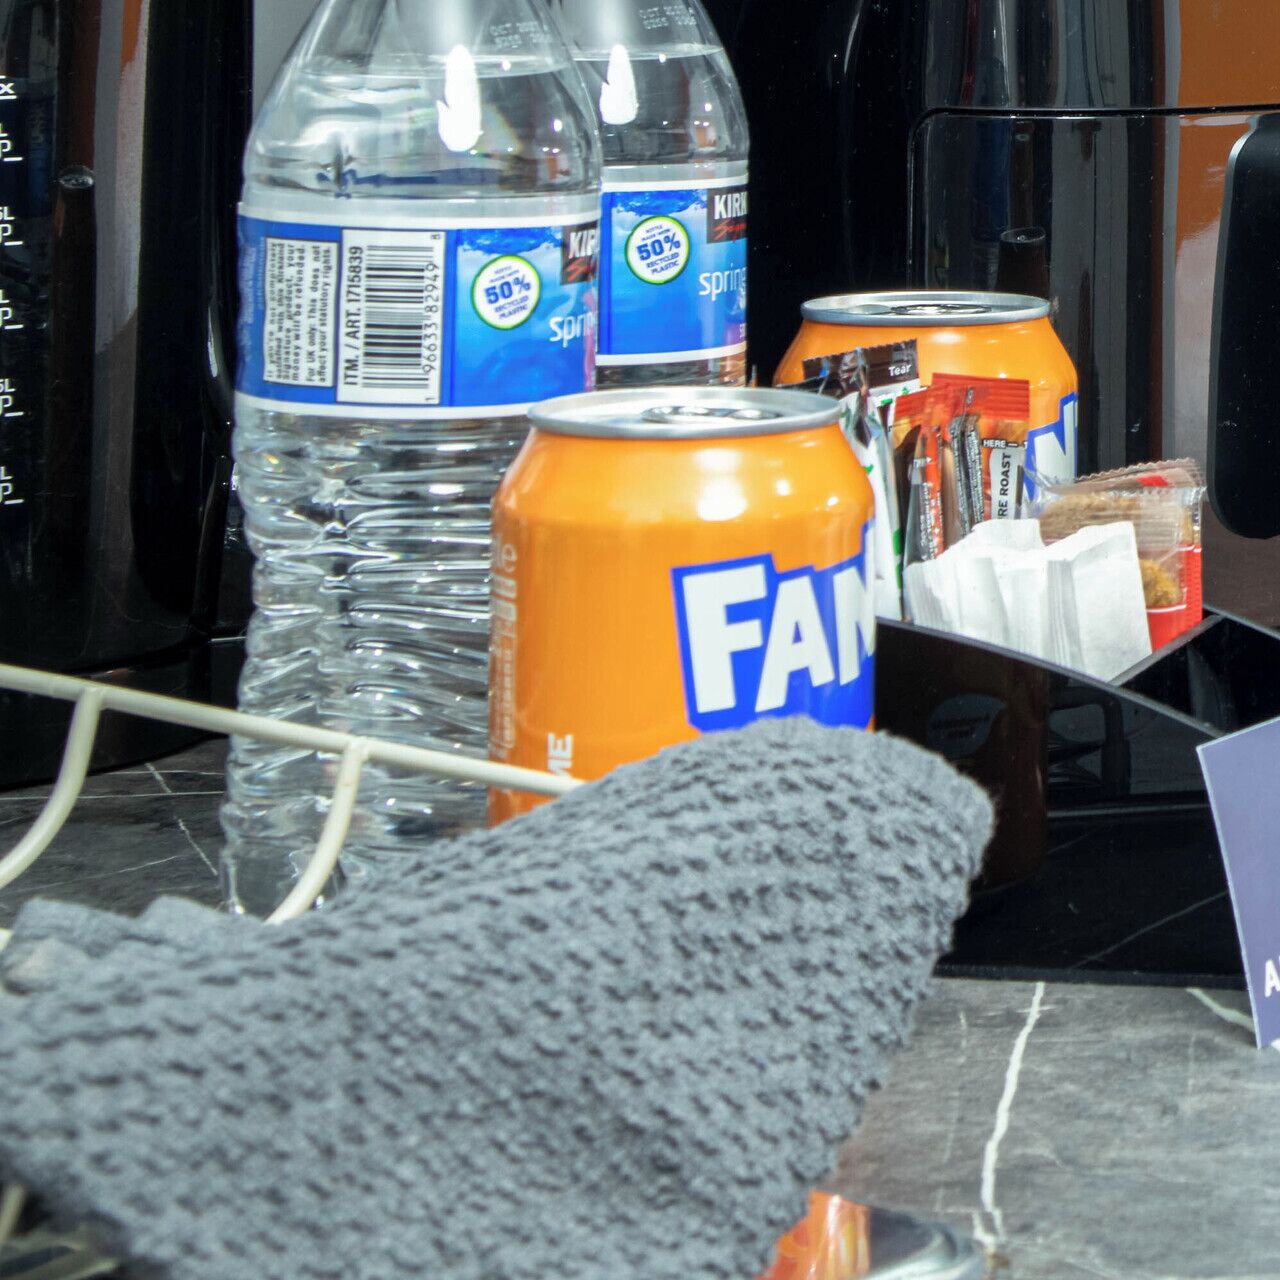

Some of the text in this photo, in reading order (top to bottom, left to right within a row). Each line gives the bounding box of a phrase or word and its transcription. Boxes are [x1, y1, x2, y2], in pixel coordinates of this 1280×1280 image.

[636, 231, 681, 261] 50%
[347, 246, 363, 304] 1715839
[484, 274, 531, 304] 50%
[345, 308, 361, 340] ART.
[344, 355, 359, 386] ITM.
[888, 363, 912, 377] Tear
[983, 439, 1006, 448] HERE
[1000, 452, 1012, 496] ROAST
